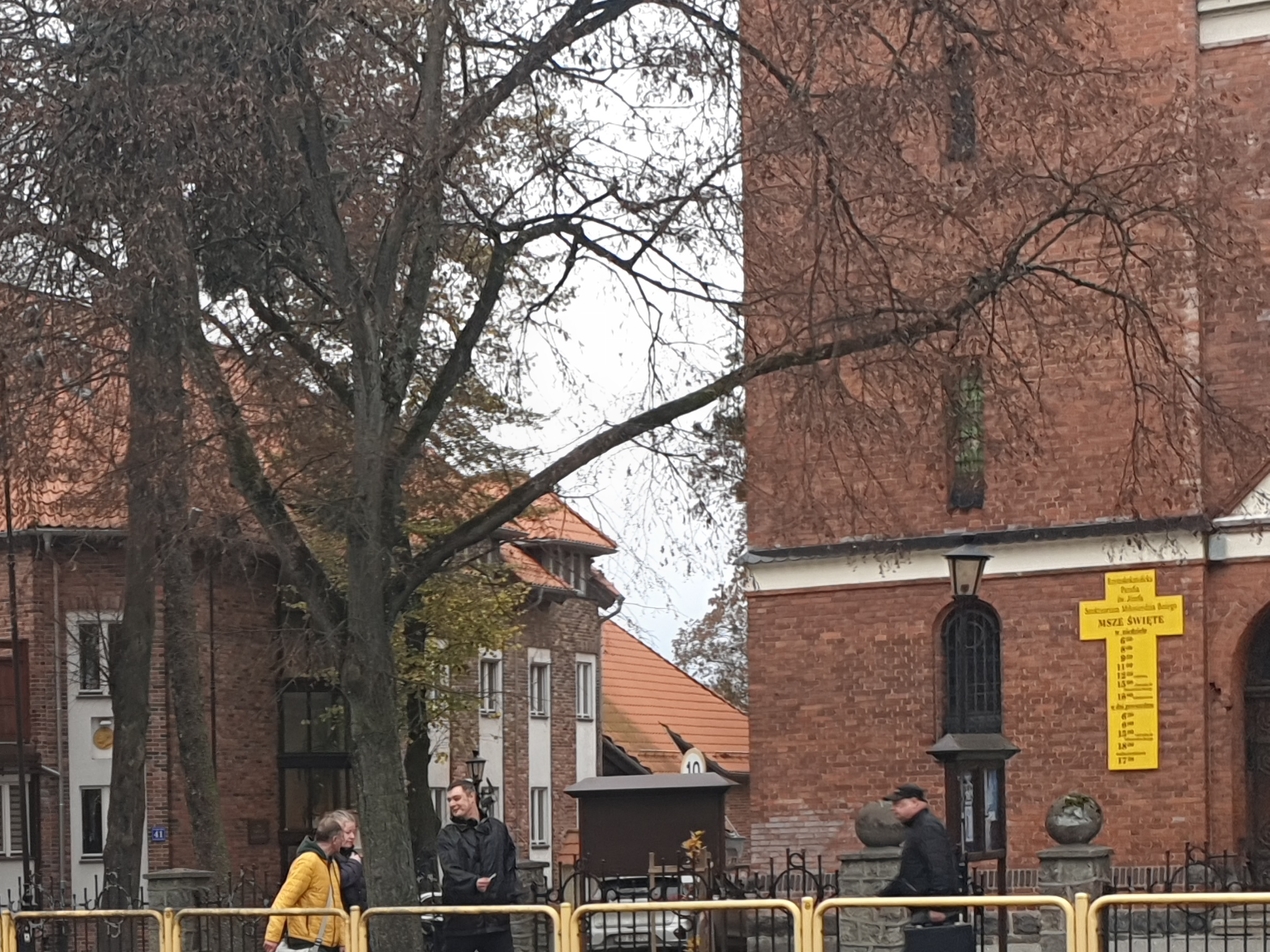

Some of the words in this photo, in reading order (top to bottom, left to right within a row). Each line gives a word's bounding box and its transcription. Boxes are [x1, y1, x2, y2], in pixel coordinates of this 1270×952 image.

[1097, 617, 1124, 628] MSZE
[1126, 615, 1165, 626] ŚWIĘTE
[153, 830, 164, 838] 41
